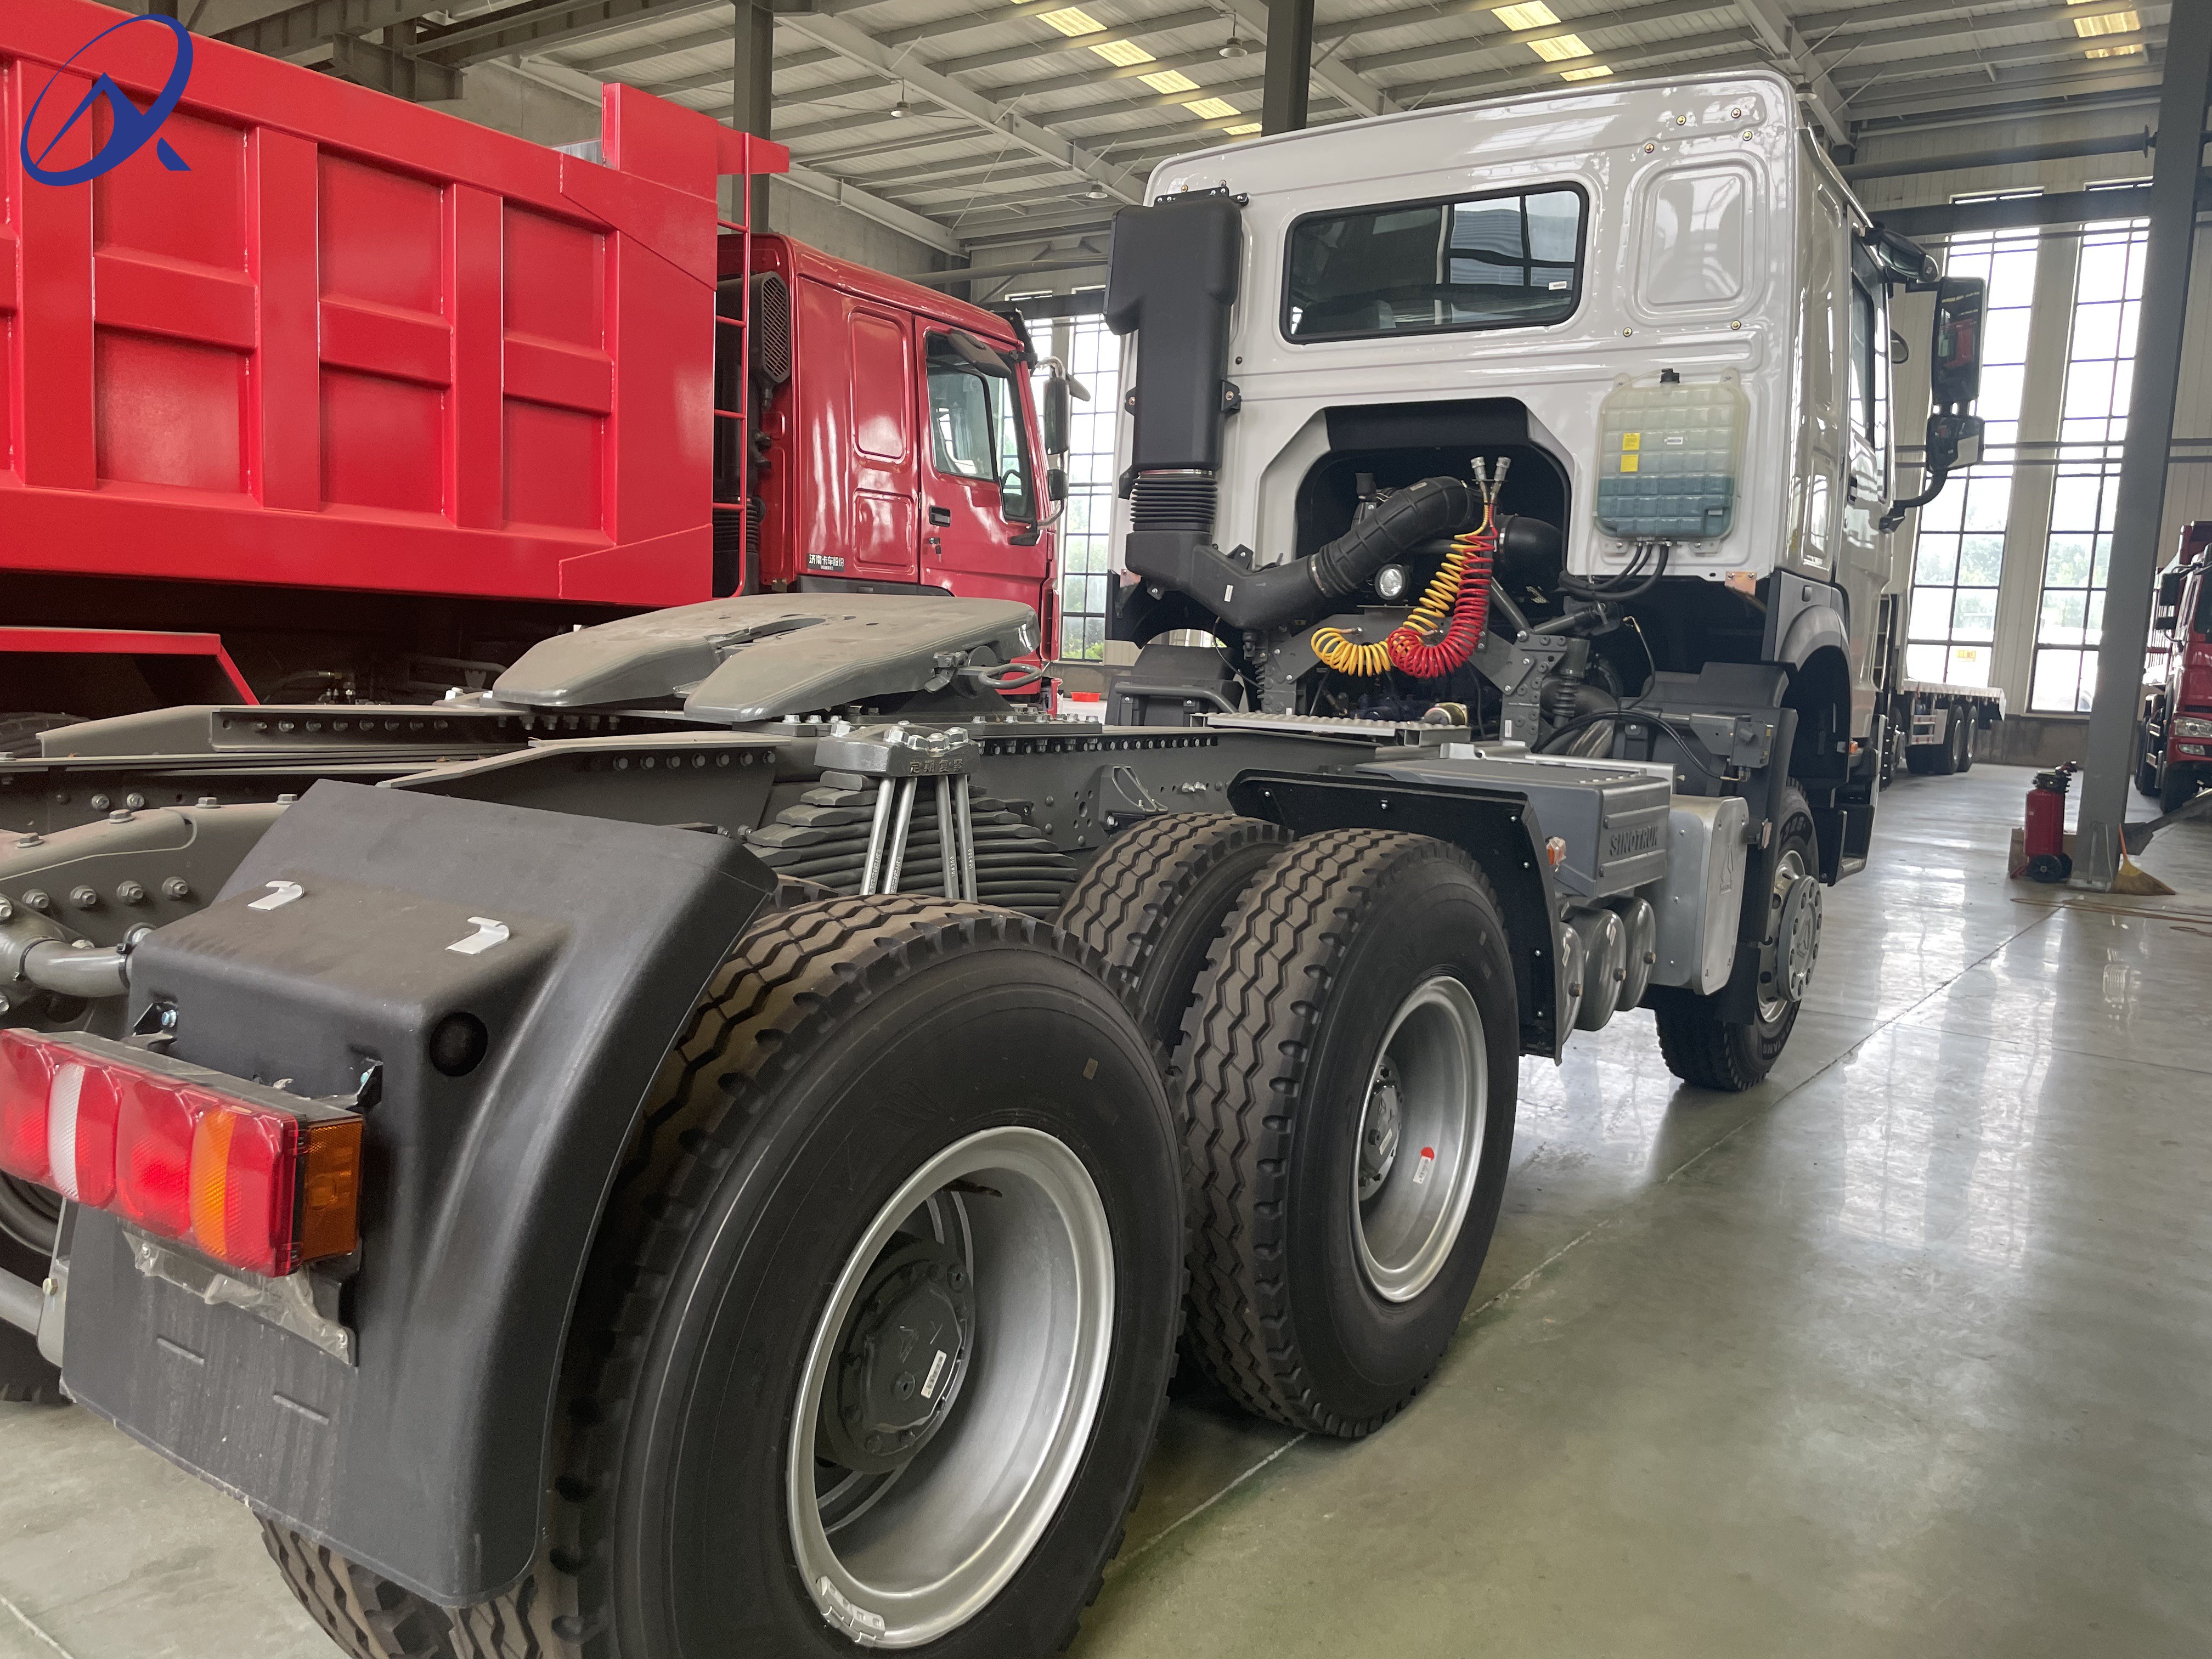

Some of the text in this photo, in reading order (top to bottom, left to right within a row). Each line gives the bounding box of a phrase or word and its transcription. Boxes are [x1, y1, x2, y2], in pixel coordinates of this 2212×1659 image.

[910, 759, 963, 773] 定期复紧
[1609, 825, 1658, 856] SINOTRUK
